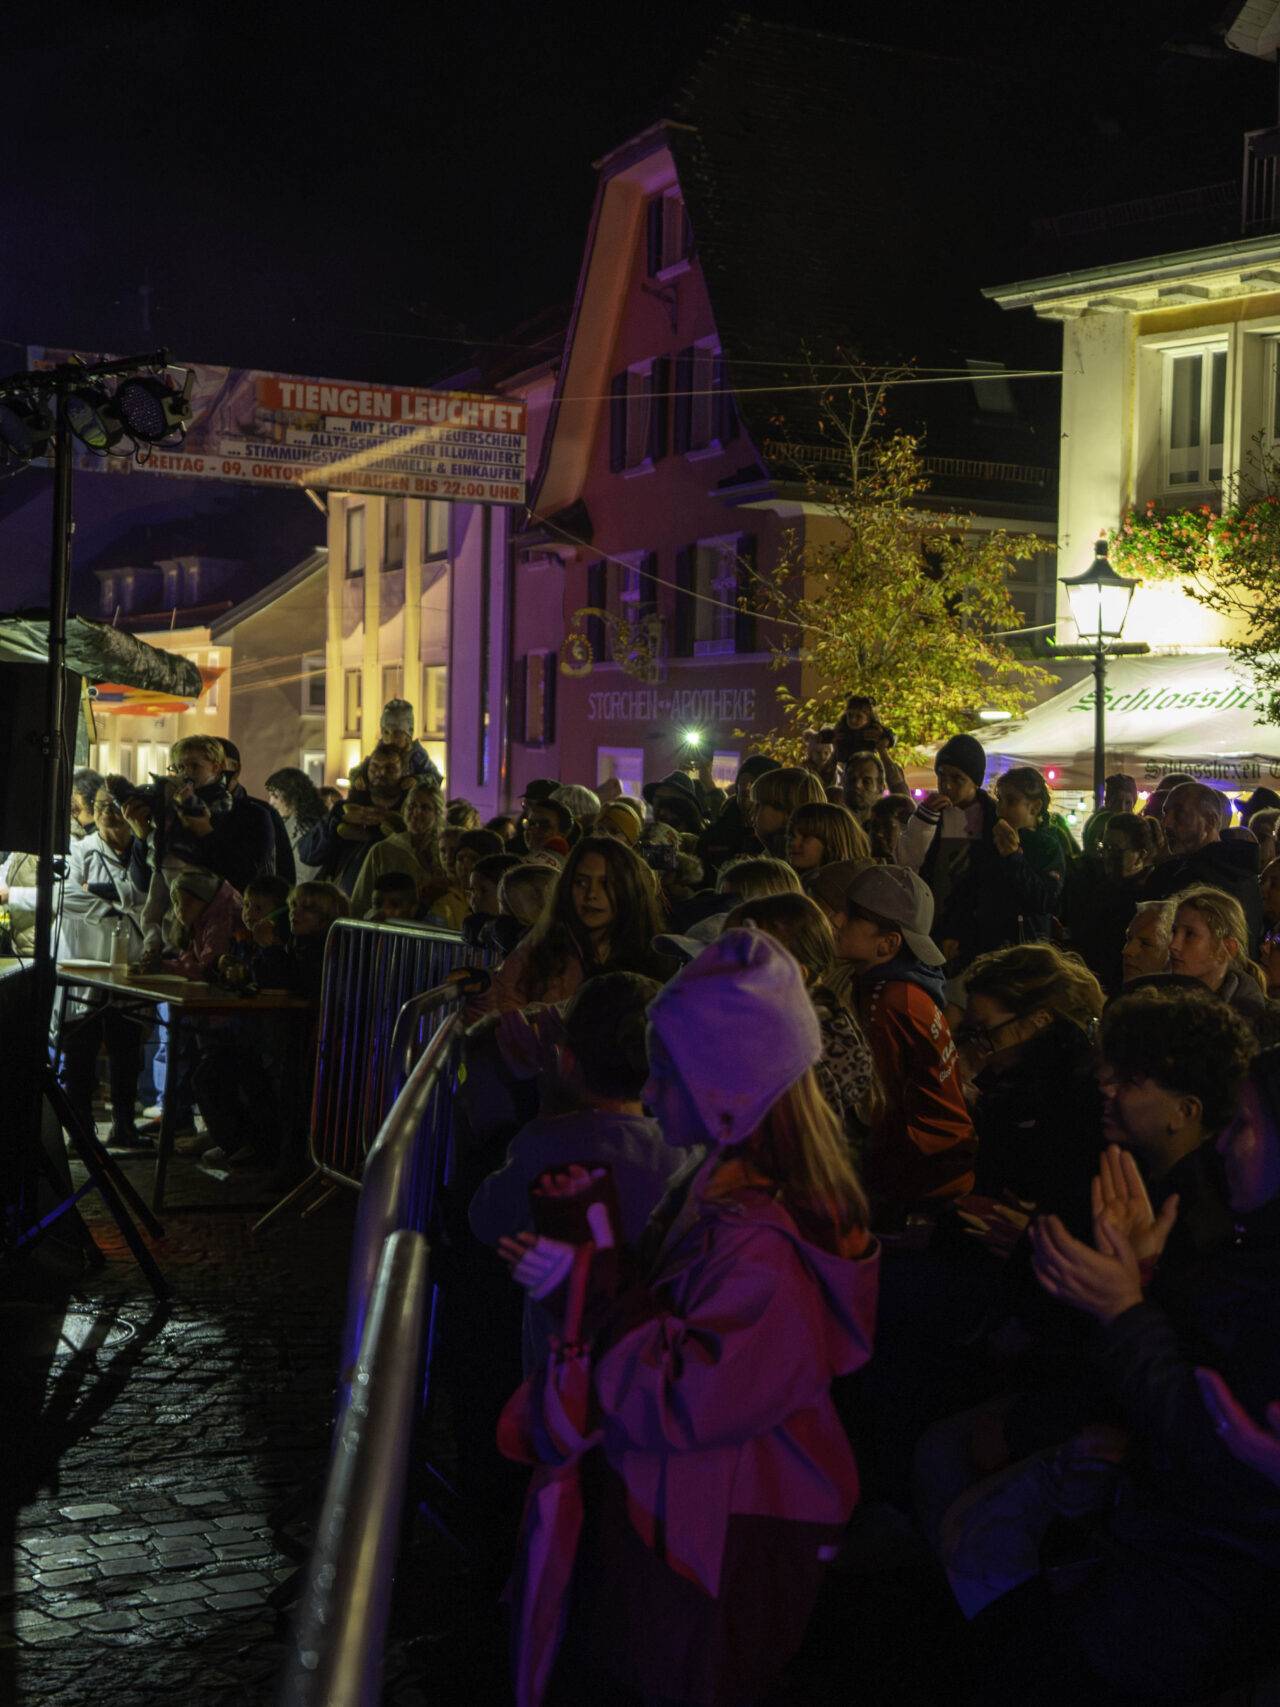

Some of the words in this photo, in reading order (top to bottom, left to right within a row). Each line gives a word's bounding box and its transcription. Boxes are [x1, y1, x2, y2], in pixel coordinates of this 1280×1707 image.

[278, 382, 392, 418] TIENGEN
[401, 393, 523, 430] LEUCHTET
[350, 420, 375, 434] MIT
[439, 428, 521, 448] FEUERSCHEIN
[439, 444, 520, 464] ILLUMINIERT
[139, 454, 204, 473] FREITAG
[222, 461, 246, 477] 09.
[328, 471, 409, 491] EINKAUFEN
[415, 478, 438, 493] BIS
[443, 480, 484, 497] 22:00
[489, 484, 520, 500] UHR
[436, 463, 446, 474] &
[451, 464, 521, 480] EINKAUFEN
[588, 691, 657, 720] STORCHEN
[670, 688, 756, 721] APOTHEKE
